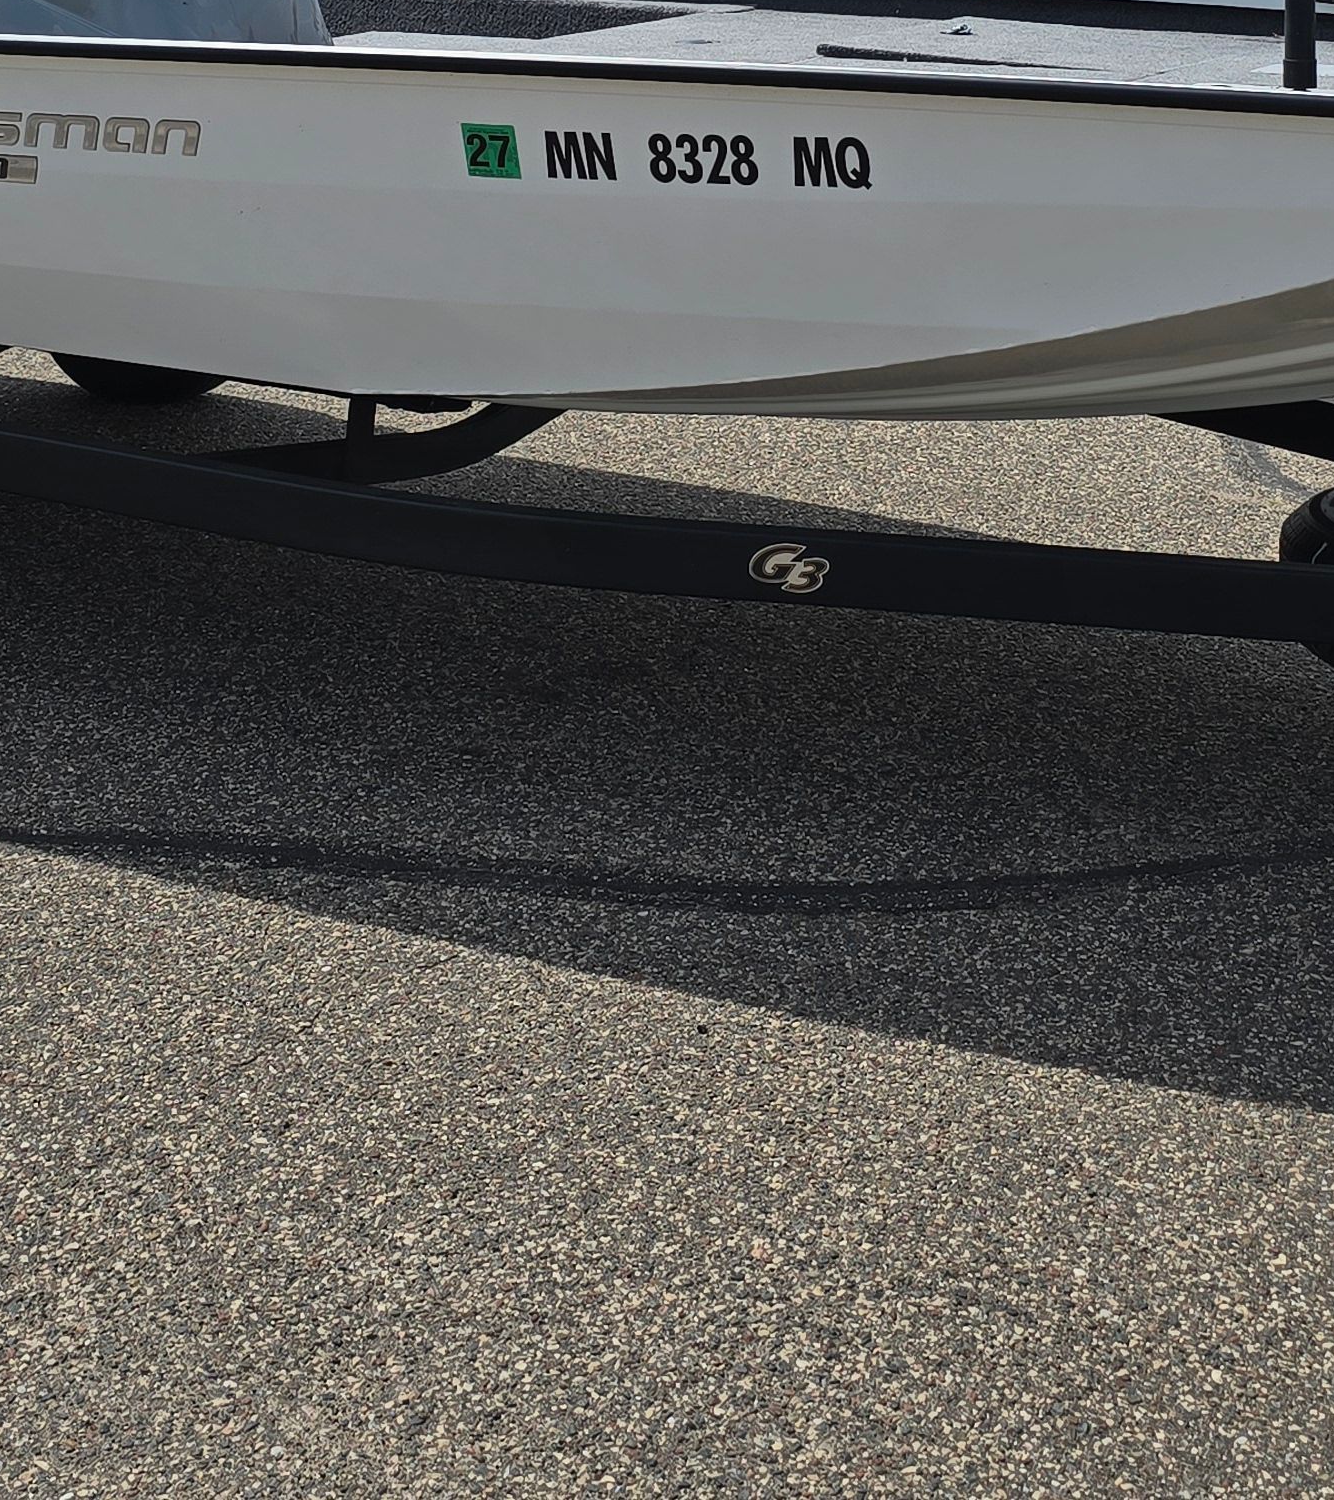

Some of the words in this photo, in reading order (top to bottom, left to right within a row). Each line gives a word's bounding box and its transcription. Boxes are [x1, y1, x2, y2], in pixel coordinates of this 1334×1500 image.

[466, 133, 510, 168] 27
[544, 130, 618, 181] MN
[648, 133, 760, 186] 8328
[793, 136, 873, 190] MQ
[748, 543, 830, 594] G3
